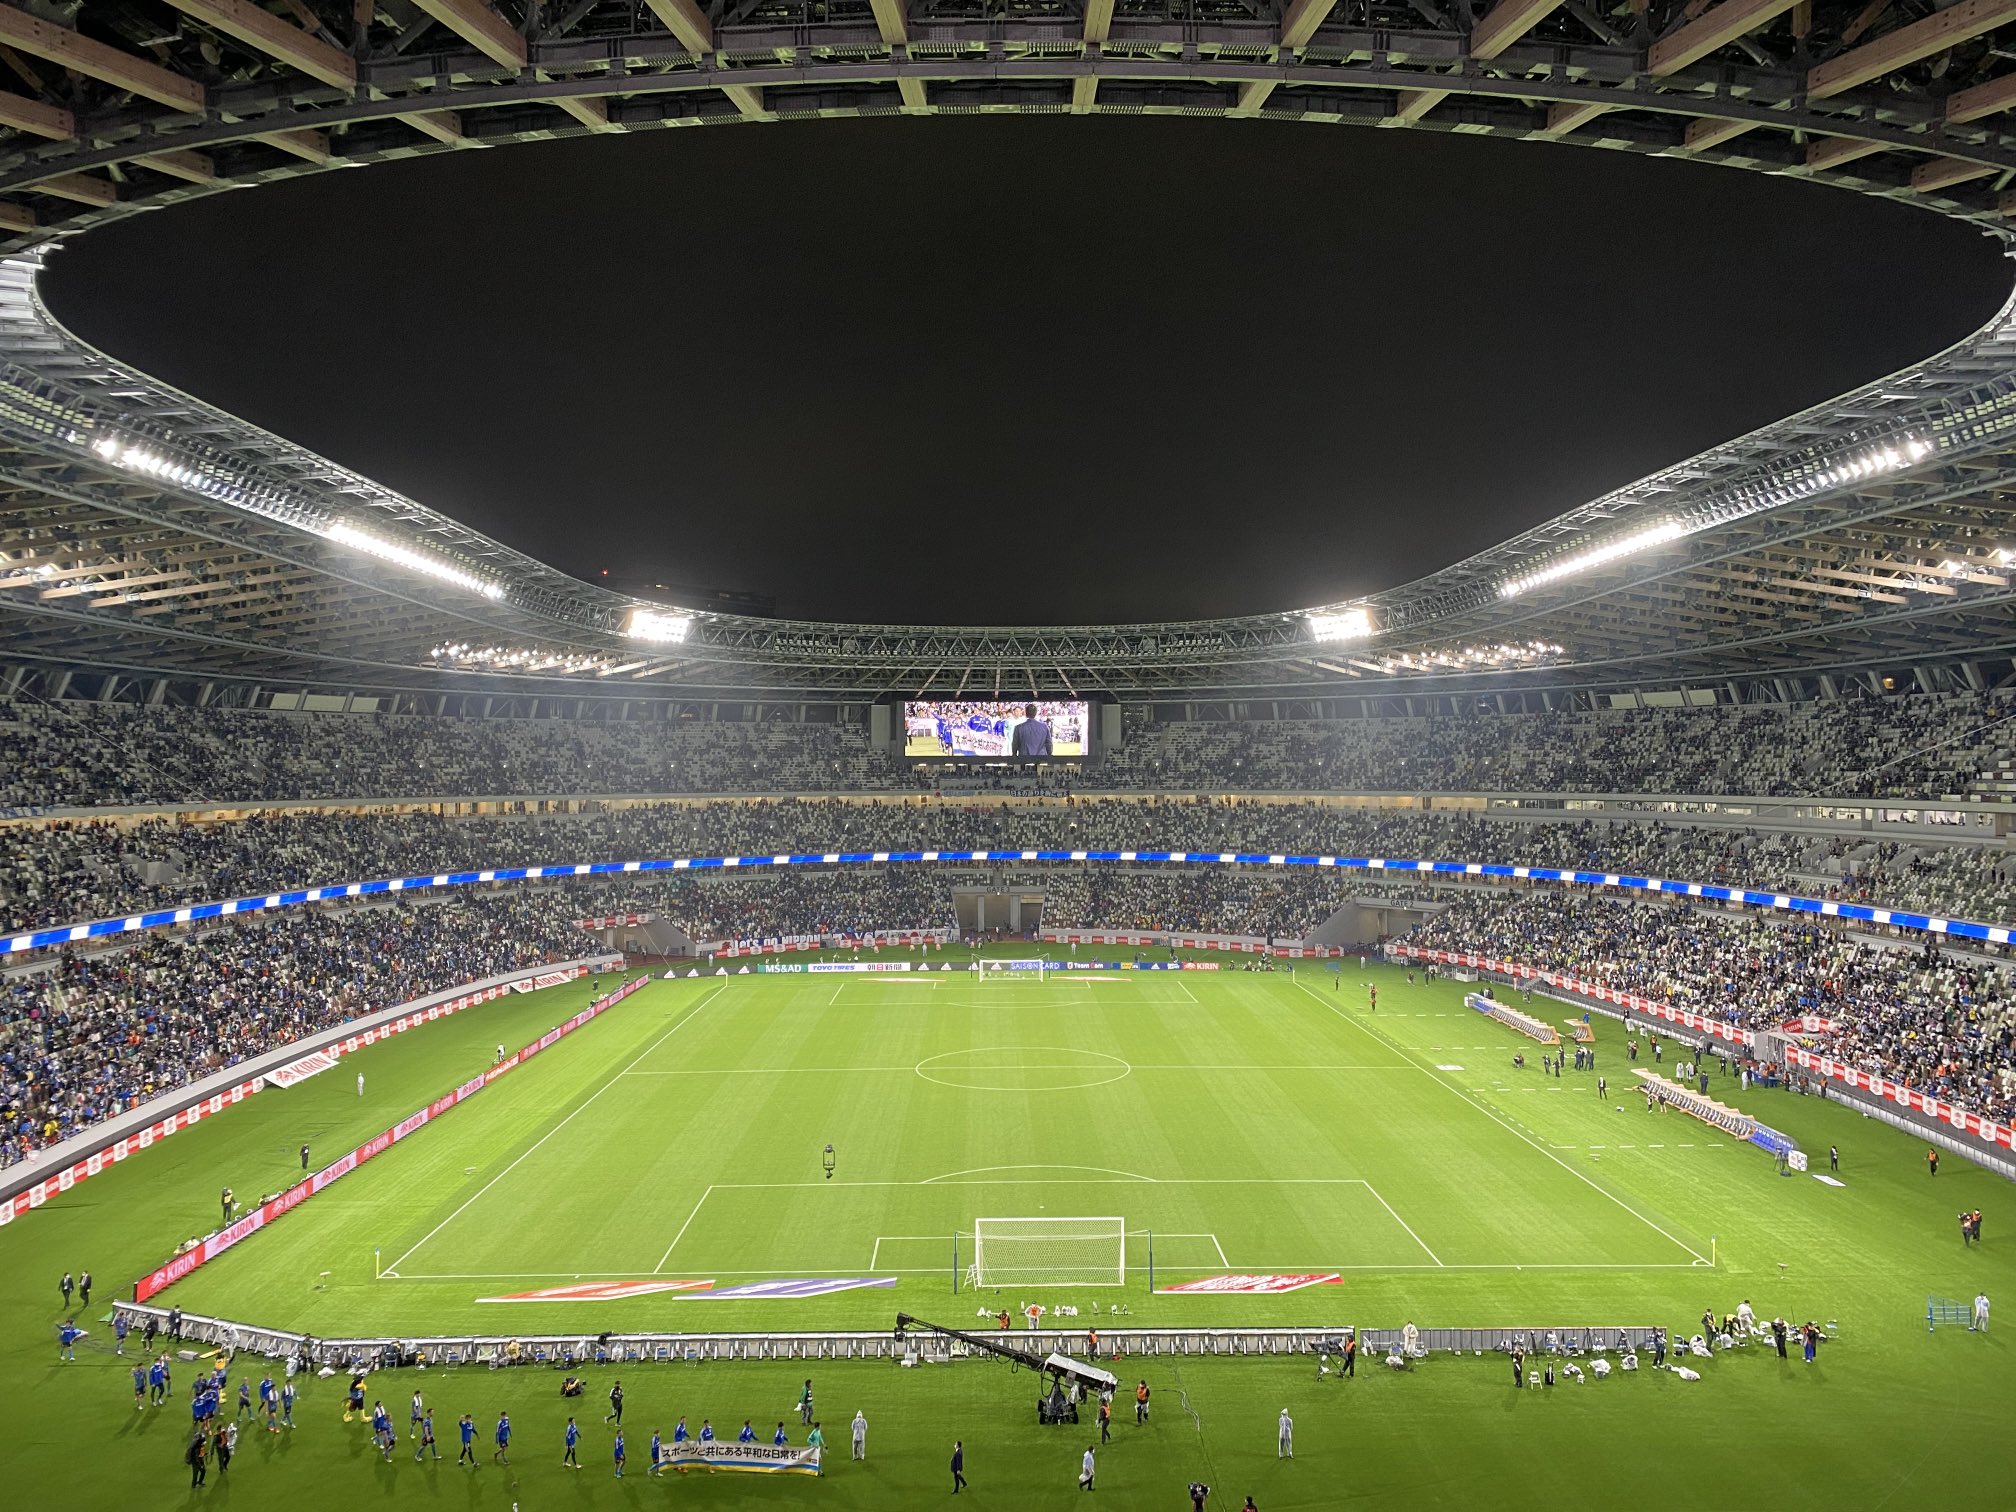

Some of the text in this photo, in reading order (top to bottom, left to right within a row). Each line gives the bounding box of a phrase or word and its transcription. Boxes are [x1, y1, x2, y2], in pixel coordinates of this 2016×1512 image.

[1391, 899, 1408, 908] GATE
[765, 964, 802, 973] MS&AD
[1196, 962, 1219, 970] KIRIN
[290, 1055, 331, 1077] KIRIN
[371, 1134, 389, 1151] KIRIN
[332, 1159, 350, 1177] KIRIN
[284, 1185, 306, 1208] KIRIN
[230, 1217, 255, 1241] KIRIN
[167, 1252, 196, 1281] KIRIN
